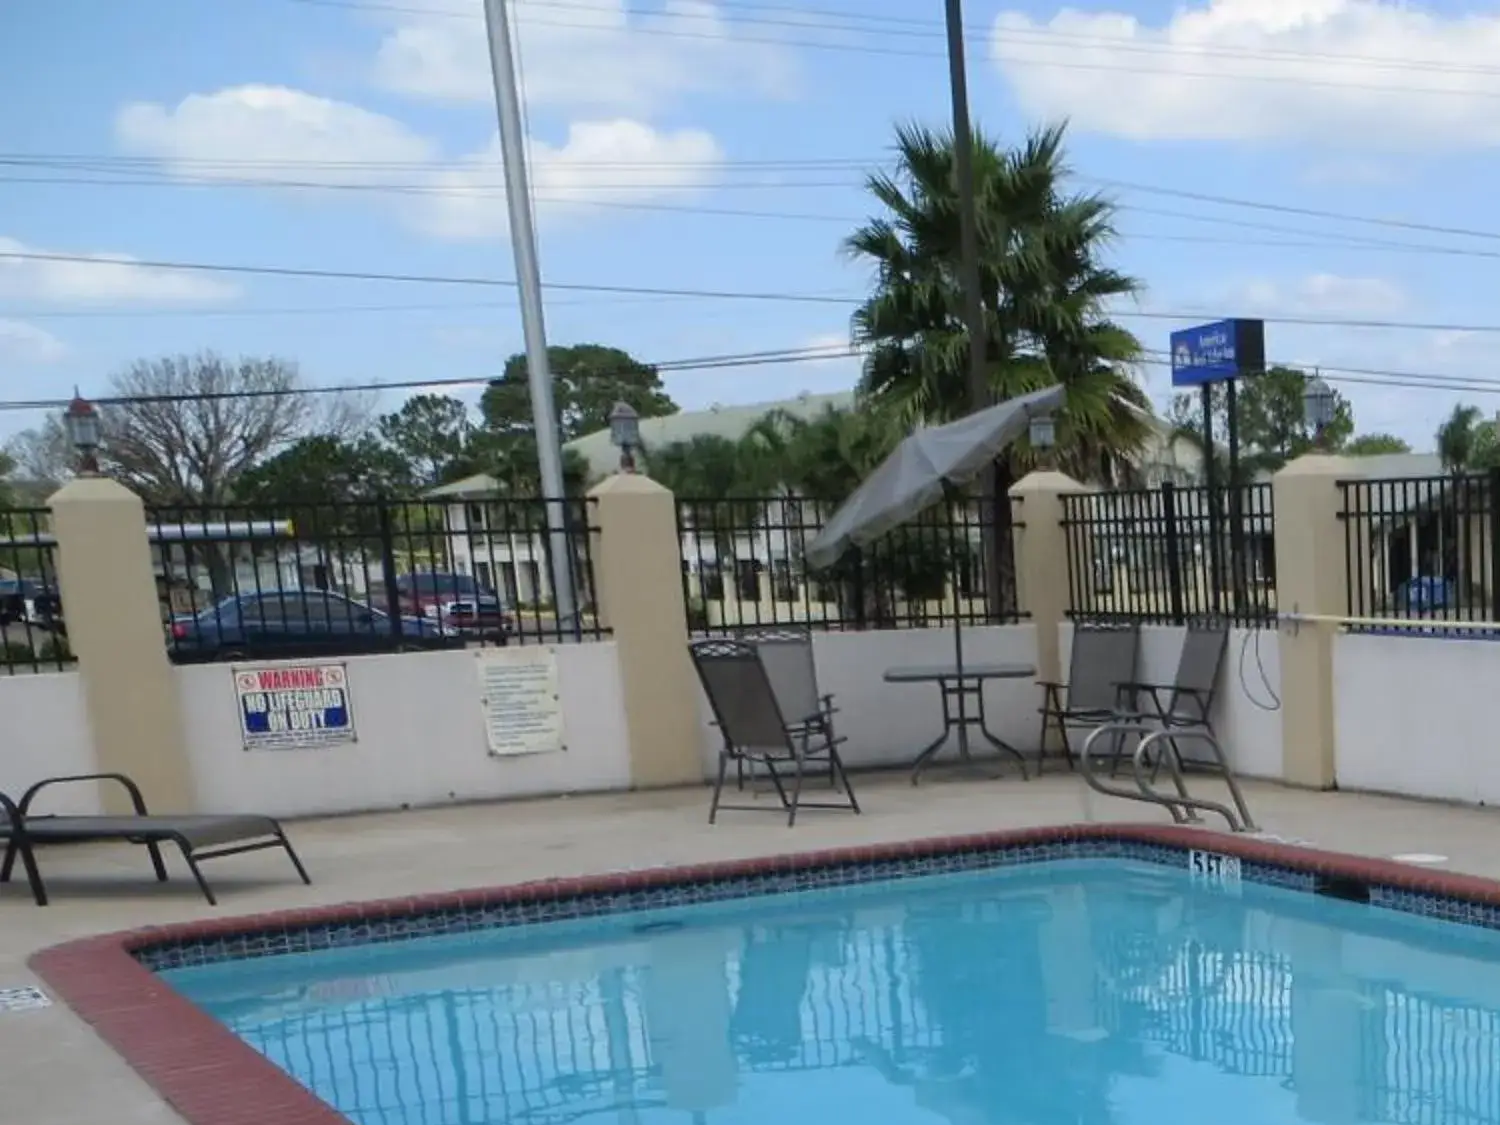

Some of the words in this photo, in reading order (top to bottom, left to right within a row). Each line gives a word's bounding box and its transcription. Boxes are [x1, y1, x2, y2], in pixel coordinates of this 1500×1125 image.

[258, 668, 324, 689] WARNING
[245, 692, 267, 712] NO
[268, 689, 342, 711] LIFEGUARD
[268, 710, 287, 731] ON
[290, 708, 325, 730] DUTY
